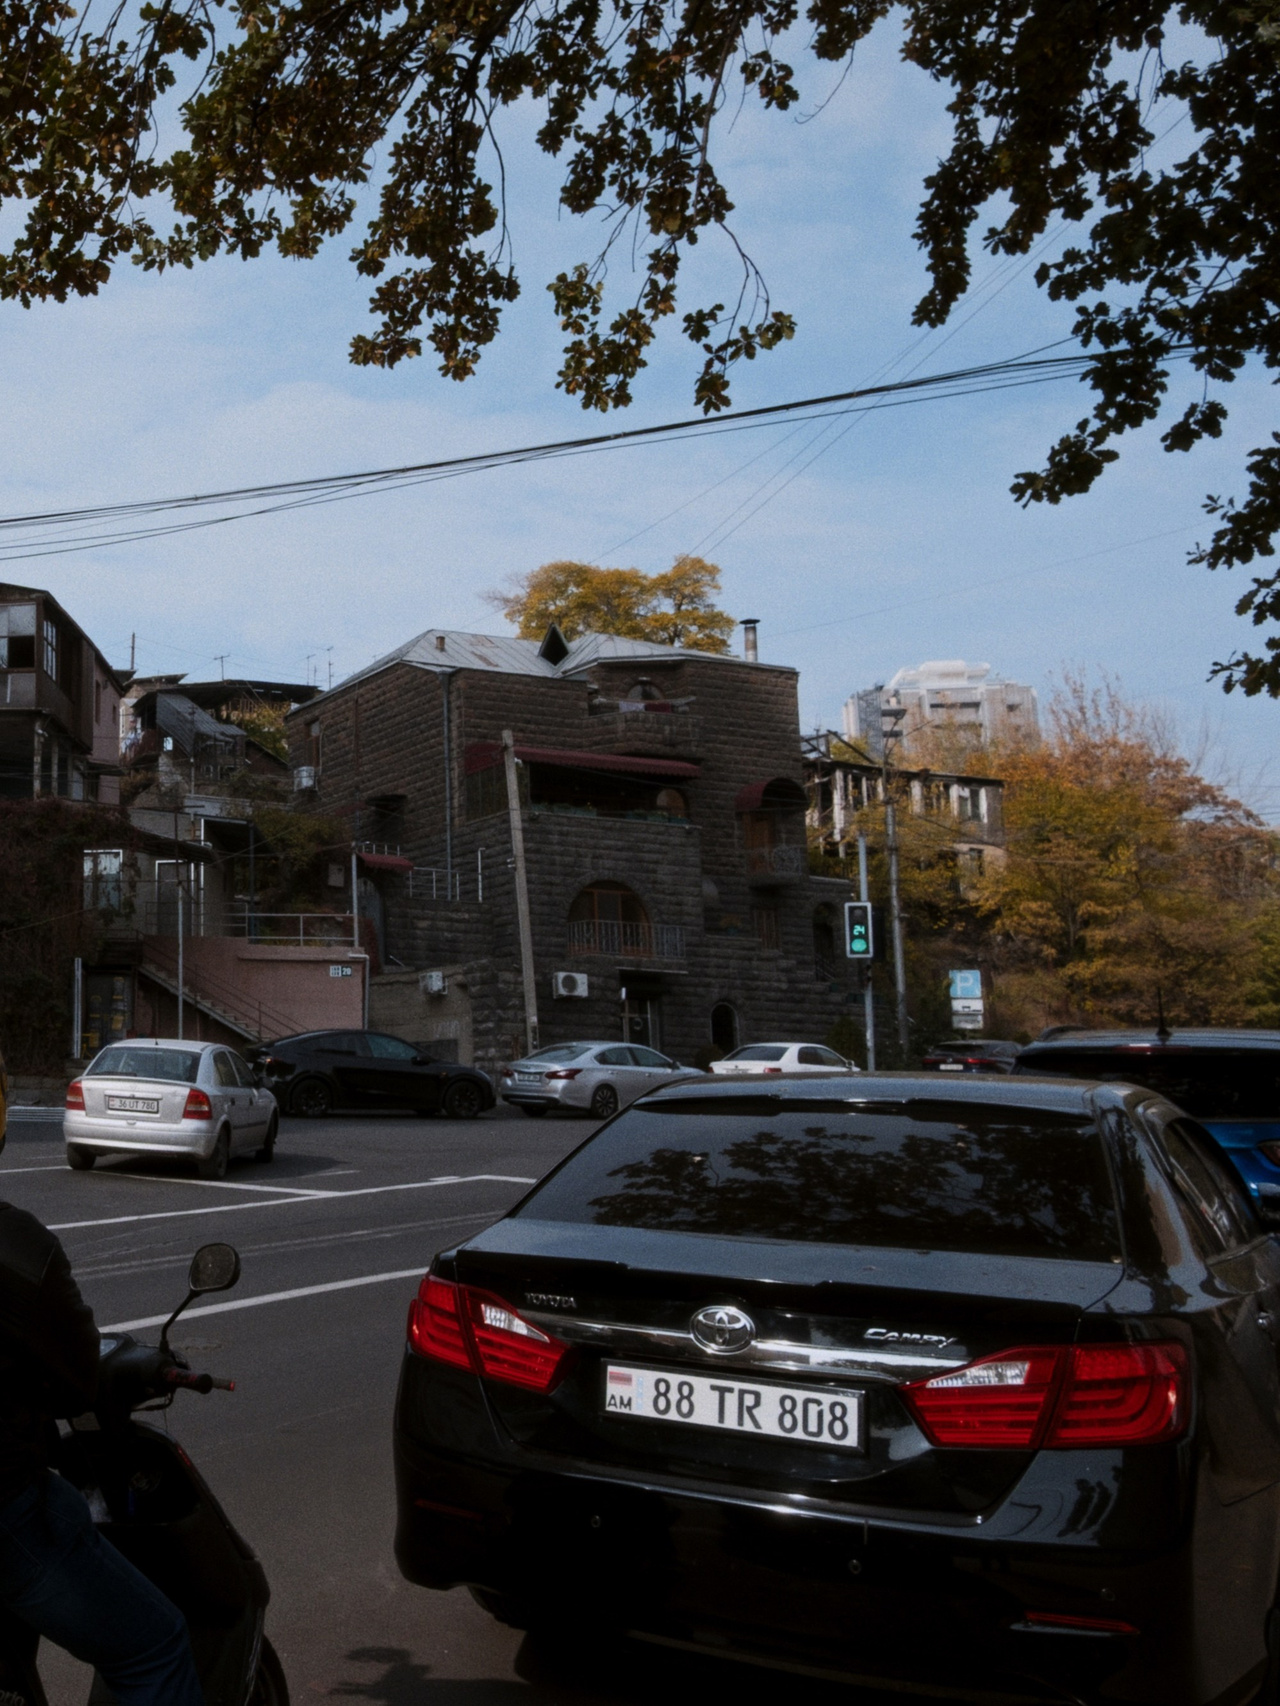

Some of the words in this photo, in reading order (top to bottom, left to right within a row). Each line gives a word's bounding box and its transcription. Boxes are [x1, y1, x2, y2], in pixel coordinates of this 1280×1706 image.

[957, 972, 973, 997] P
[524, 1292, 578, 1309] TOYOTA
[607, 1393, 632, 1411] AM
[652, 1377, 695, 1419] 88
[710, 1384, 762, 1430] TR
[778, 1394, 849, 1441] 808
